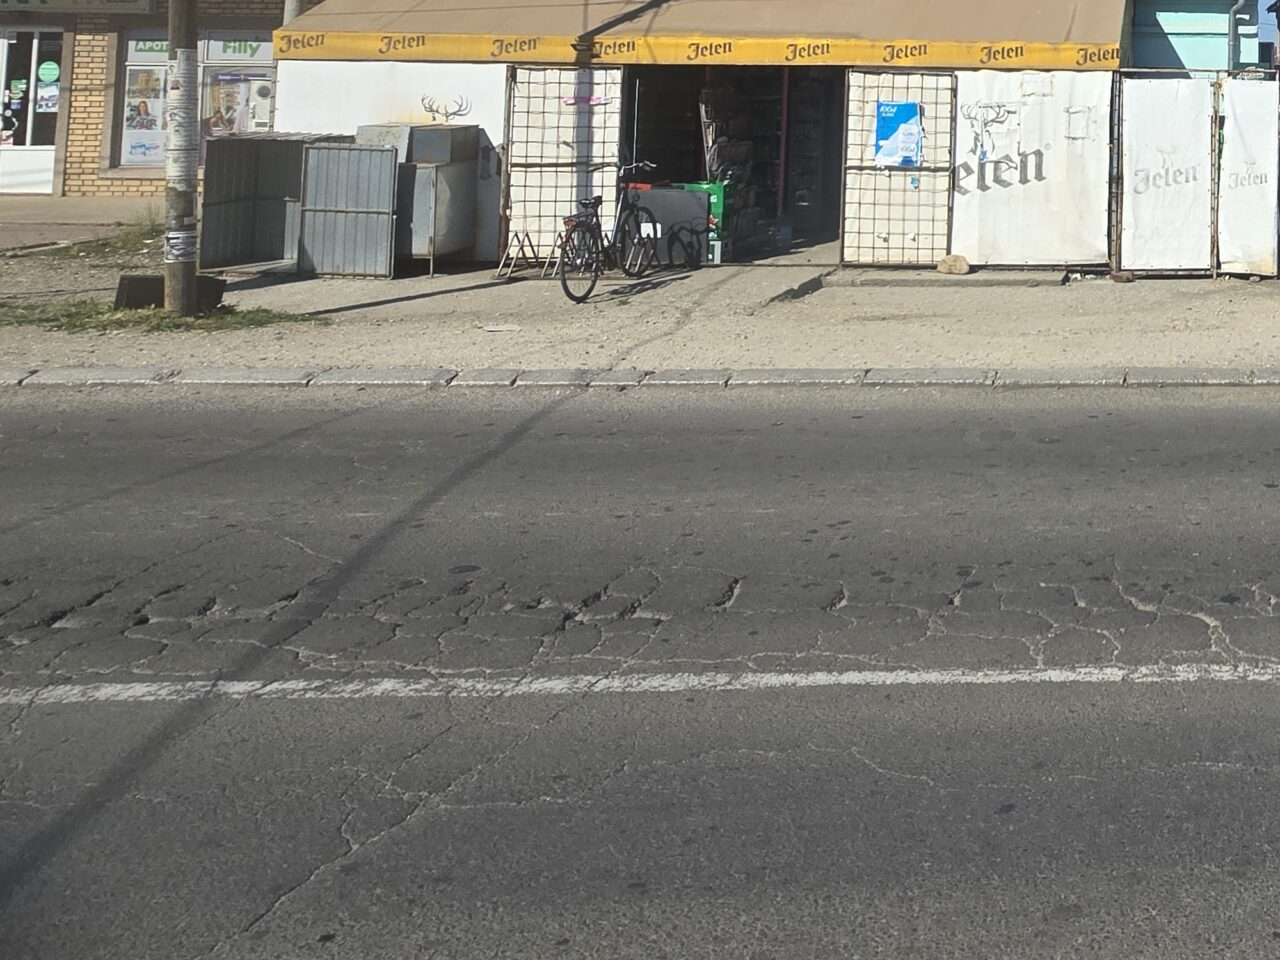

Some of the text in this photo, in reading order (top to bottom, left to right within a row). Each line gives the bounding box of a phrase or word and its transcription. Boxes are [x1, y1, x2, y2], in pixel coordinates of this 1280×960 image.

[222, 40, 261, 57] Filly
[279, 34, 1120, 66] Jelen Jelen Jelen Jelen Jelen Jelen Jelen Jelen Jelen
[1133, 166, 1198, 194] Jelen
[1228, 172, 1268, 190] Jelen
